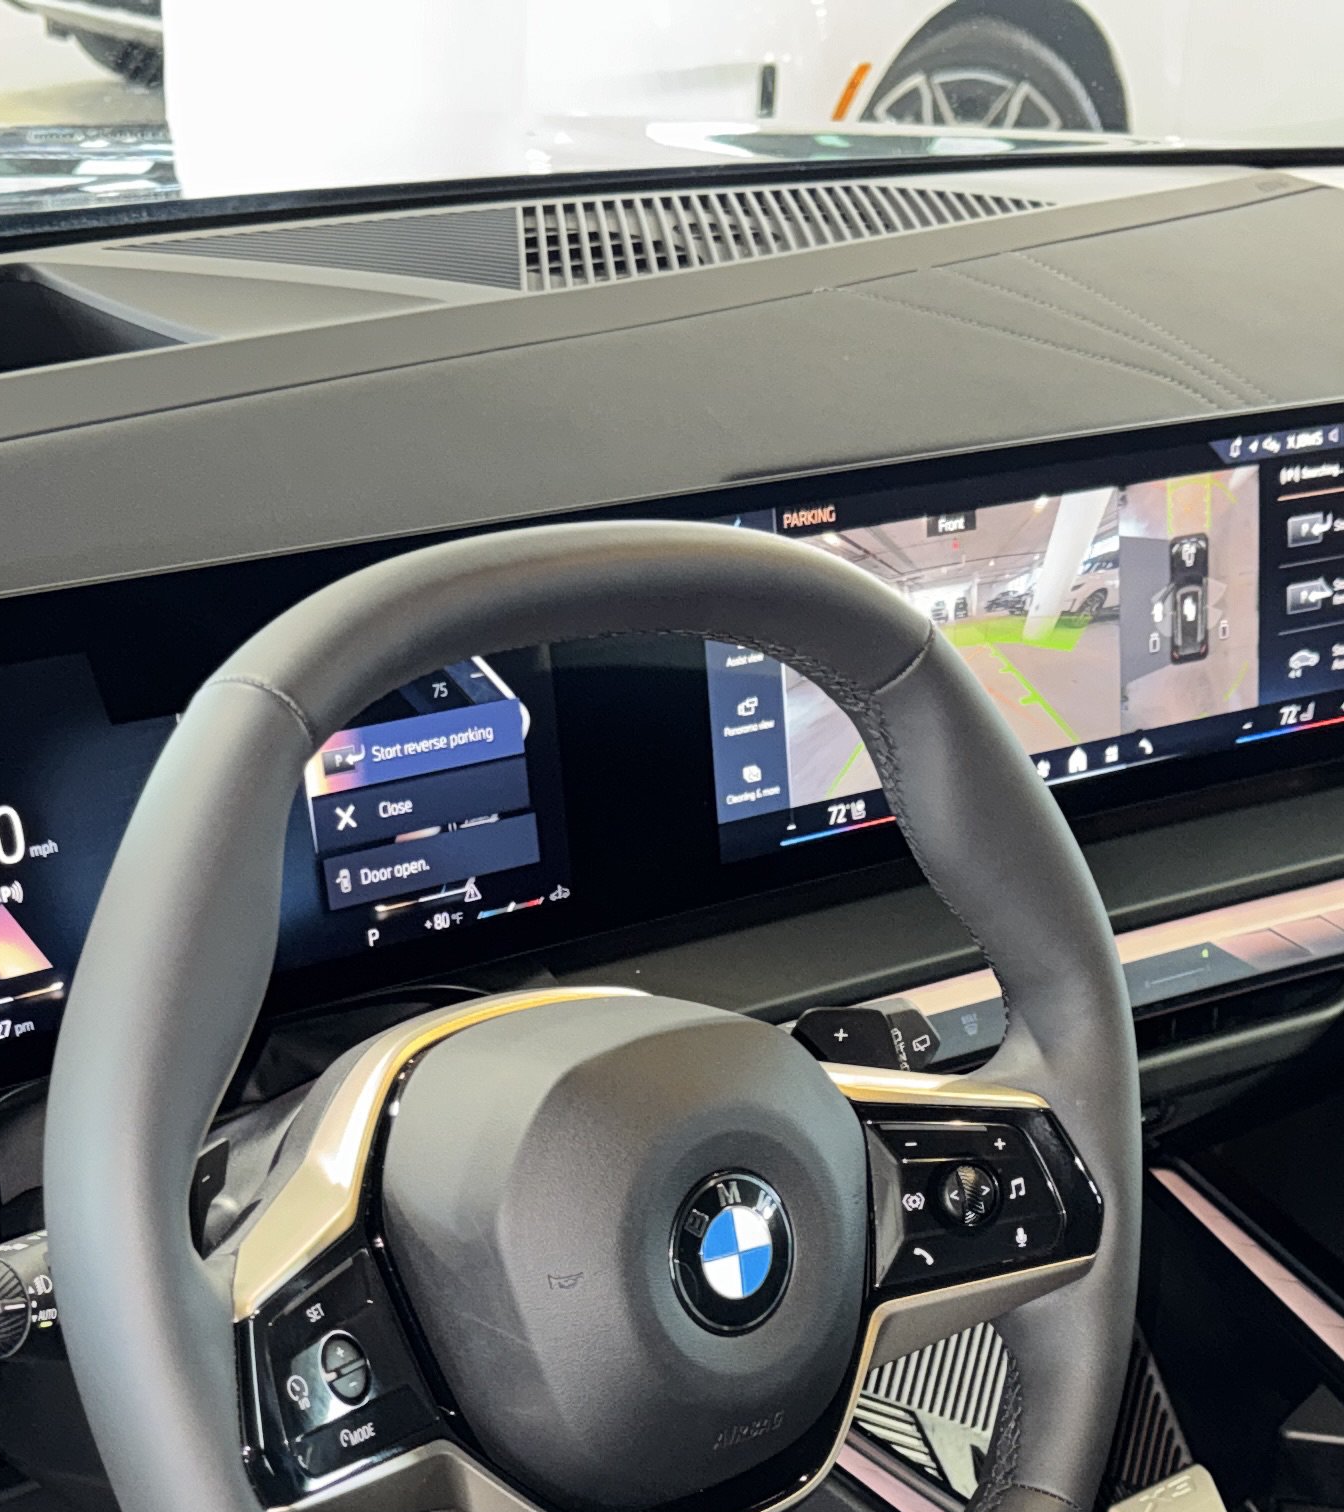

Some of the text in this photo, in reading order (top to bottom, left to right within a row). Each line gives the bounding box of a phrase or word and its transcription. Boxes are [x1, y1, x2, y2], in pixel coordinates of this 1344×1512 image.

[783, 506, 836, 529] PARKING
[938, 516, 965, 533] Front
[432, 682, 448, 699] 75
[372, 726, 494, 762] Start reverse parking
[378, 799, 413, 819] Close
[29, 841, 59, 860] mph
[360, 859, 431, 886] Door open.
[367, 928, 380, 947] P
[306, 1302, 325, 1323] SET
